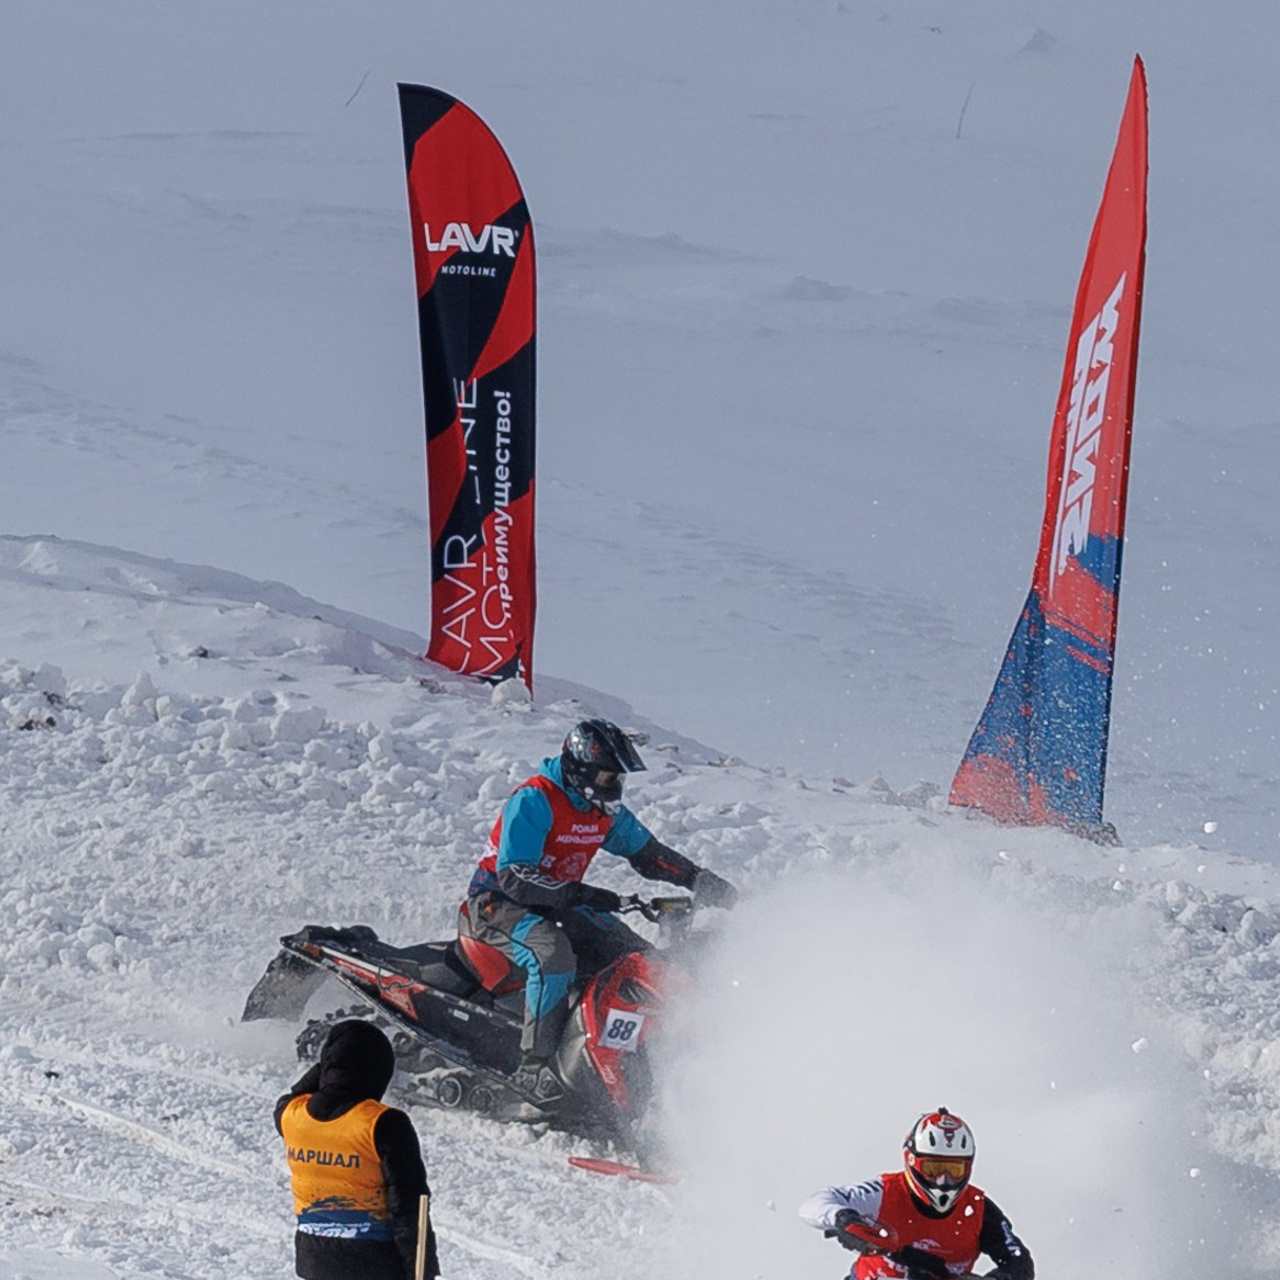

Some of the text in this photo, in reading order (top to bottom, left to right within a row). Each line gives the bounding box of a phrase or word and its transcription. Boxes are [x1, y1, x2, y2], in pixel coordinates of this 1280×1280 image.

[424, 222, 516, 258] LAVR
[441, 265, 497, 277] MOTOLINE
[607, 1018, 637, 1041] 88
[287, 1146, 360, 1169] МАРШАЛ
